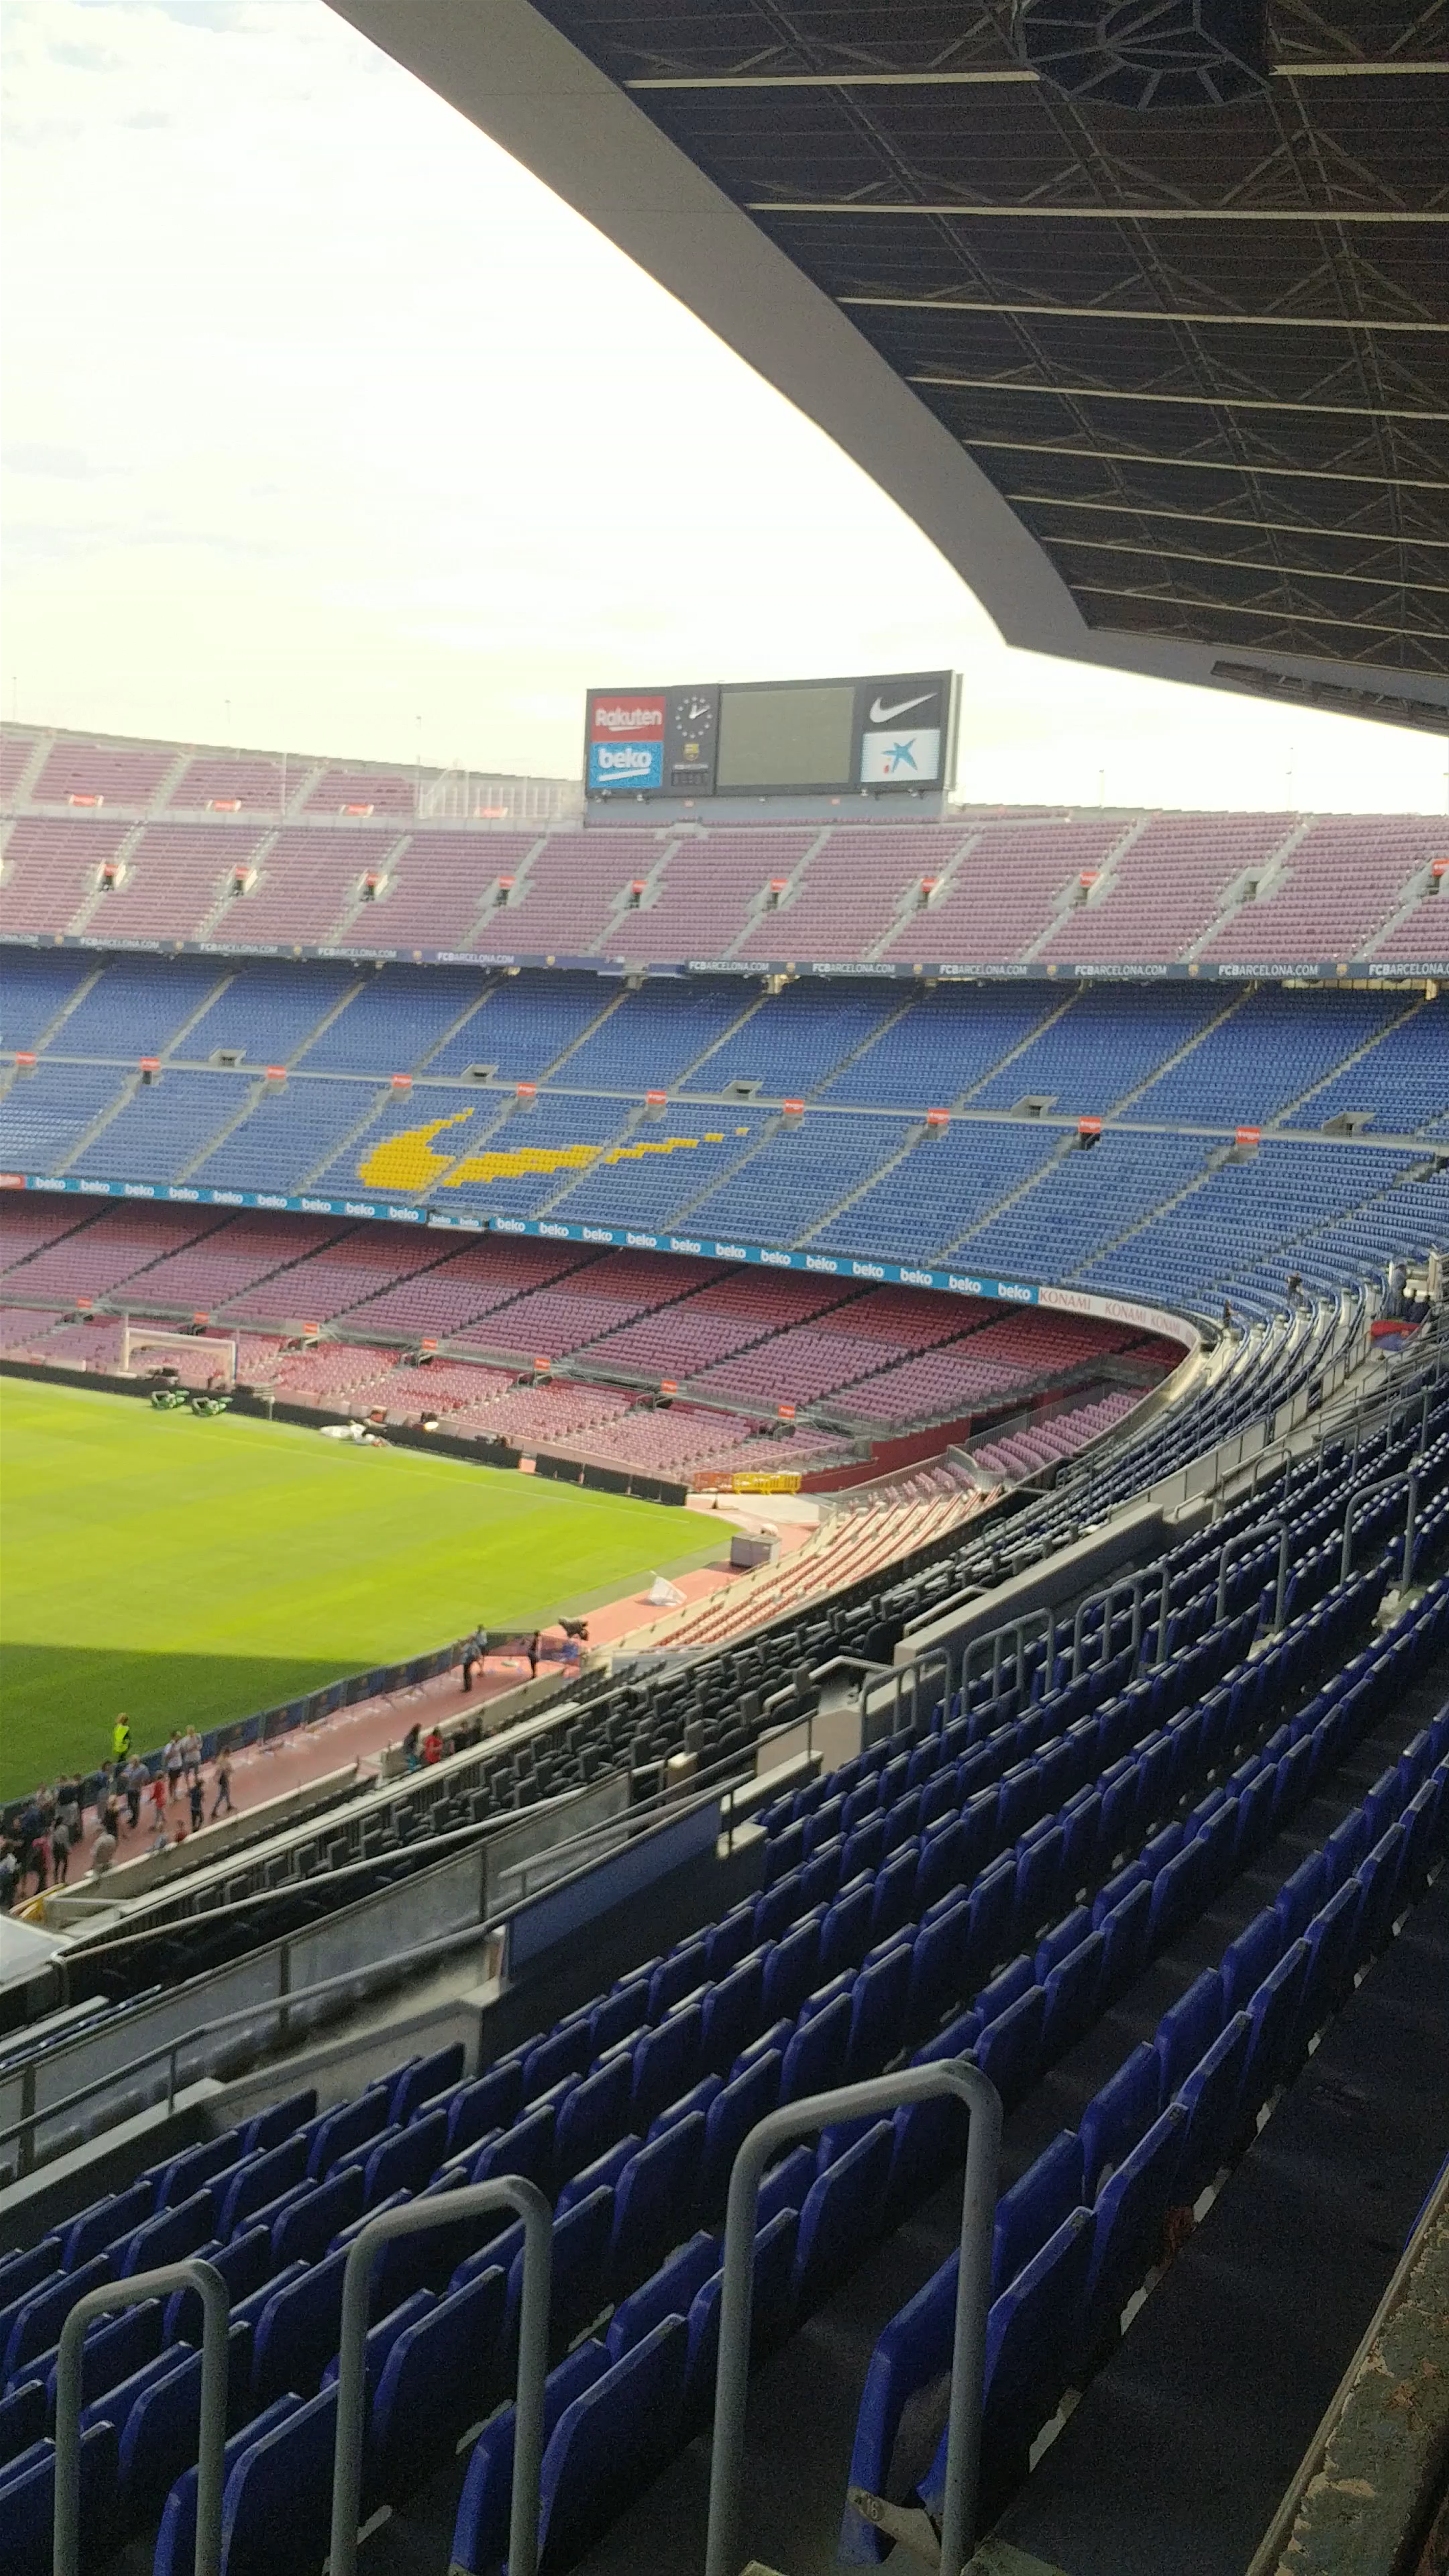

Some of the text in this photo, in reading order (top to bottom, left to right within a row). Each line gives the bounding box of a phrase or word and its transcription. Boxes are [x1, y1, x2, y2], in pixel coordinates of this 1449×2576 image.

[595, 707, 662, 726] Rakuten
[598, 748, 652, 768] beko
[689, 961, 769, 971] FCBARCELONA.COM
[813, 963, 895, 973] FCBARCELONA.COM
[940, 964, 1027, 975] FCBARCELONA.COM
[1075, 965, 1166, 975] FCBARCELONA.COM
[1218, 964, 1318, 976] FCBARCELONA.COM
[257, 1195, 287, 1208] beko
[301, 1198, 331, 1212] beko
[345, 1203, 375, 1216] beko
[389, 1206, 419, 1220] beko
[496, 1218, 526, 1232] beko
[539, 1223, 569, 1237] beko
[583, 1227, 612, 1242] beko
[626, 1232, 657, 1247] beko
[671, 1238, 701, 1253] beko
[716, 1243, 746, 1258] beko
[760, 1249, 791, 1265] beko
[806, 1256, 837, 1271] beko
[853, 1262, 884, 1278] beko
[900, 1268, 932, 1286] beko
[949, 1275, 981, 1293] beko
[998, 1283, 1031, 1301] beko
[1040, 1288, 1091, 1310] KONAMI
[1105, 1301, 1146, 1323] KONAMI
